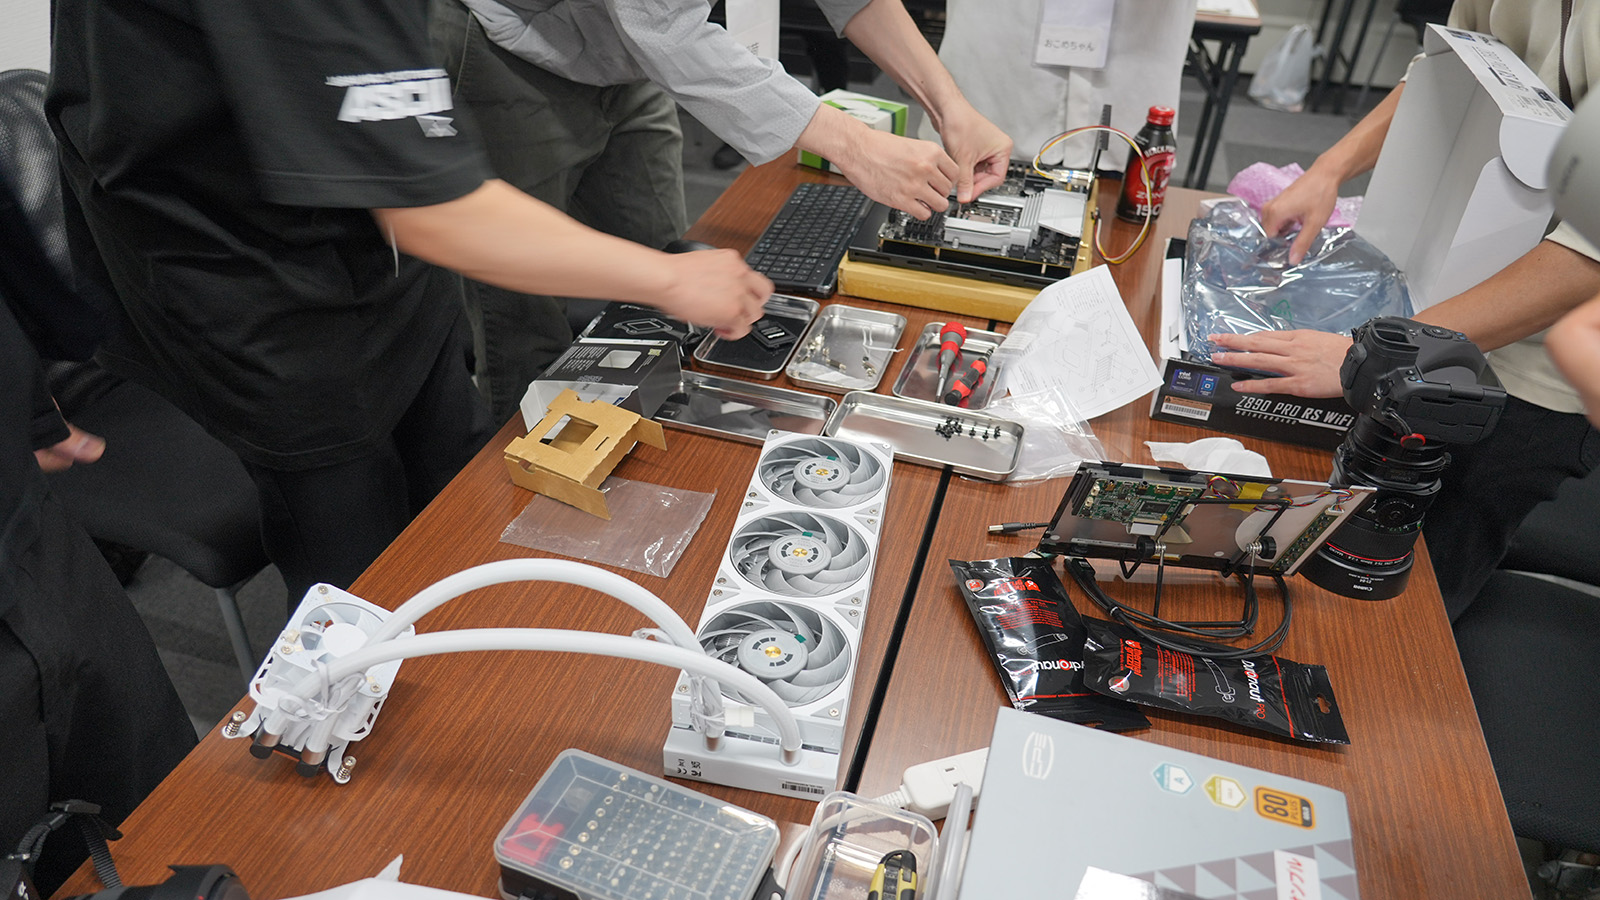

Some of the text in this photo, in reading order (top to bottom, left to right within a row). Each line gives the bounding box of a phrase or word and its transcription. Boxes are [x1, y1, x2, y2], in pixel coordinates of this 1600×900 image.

[1044, 39, 1096, 52] おこめちゃん
[1236, 396, 1355, 427] Z890 PRO RS WiFi
[1353, 584, 1373, 592] Canon
[1255, 702, 1266, 720] PRO
[1263, 793, 1289, 817] 80
